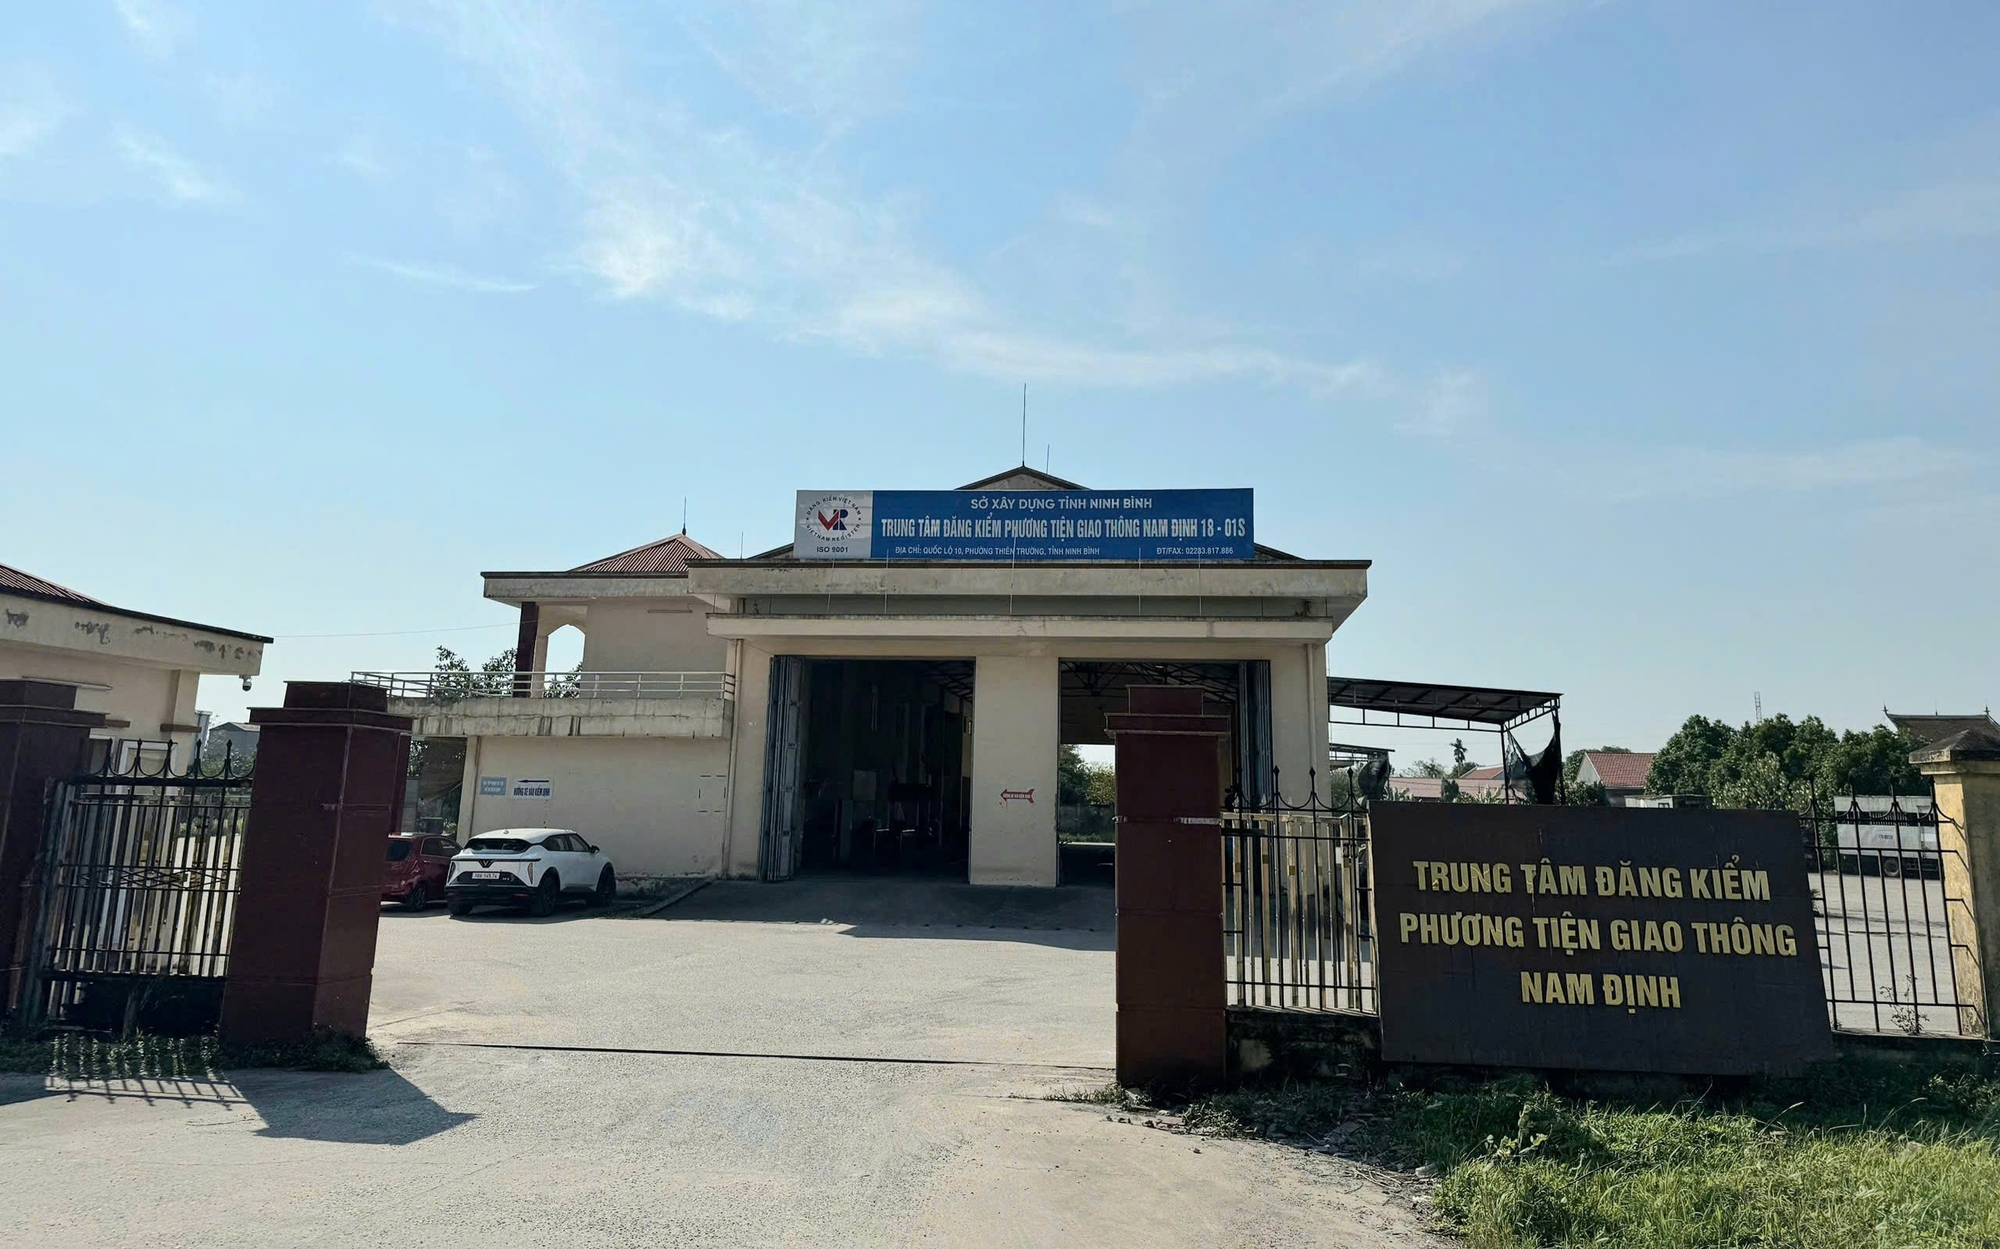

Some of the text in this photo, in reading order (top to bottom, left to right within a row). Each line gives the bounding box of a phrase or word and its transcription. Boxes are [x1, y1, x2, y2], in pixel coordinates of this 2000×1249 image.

[971, 495, 1152, 512] SỞ XÂY DỰNG TỈNH NINH BÌNH
[881, 518, 916, 538] TRUNG
[918, 515, 941, 538] TÂM
[943, 515, 972, 538] ĐĂNG
[974, 511, 1002, 538] KIỂM
[1004, 517, 1048, 538] PHƯƠNG
[1050, 515, 1074, 542] TIỆN
[1077, 518, 1102, 538] GIAO
[1104, 515, 1140, 538] THÔNG
[1143, 518, 1168, 538] NAM
[1171, 518, 1198, 542] ĐỊNH
[1200, 518, 1214, 537] 18
[1224, 518, 1246, 538] 01S
[923, 544, 942, 555] QUỐC
[943, 545, 953, 556] LỘ
[964, 545, 993, 555] PHƯỜNG
[1047, 545, 1064, 555] TỈNH
[1065, 547, 1082, 555] NINH
[1083, 545, 1100, 555] BÌNH
[1156, 547, 1184, 555] ĐT/FAX:
[1413, 853, 1772, 901] TRUNG TÂM ĐĂNG KIỂM
[1400, 910, 1797, 957] PHƯƠNG TIỆN GIAO THÔNG
[1519, 970, 1682, 1014] NAM ĐỊNH
